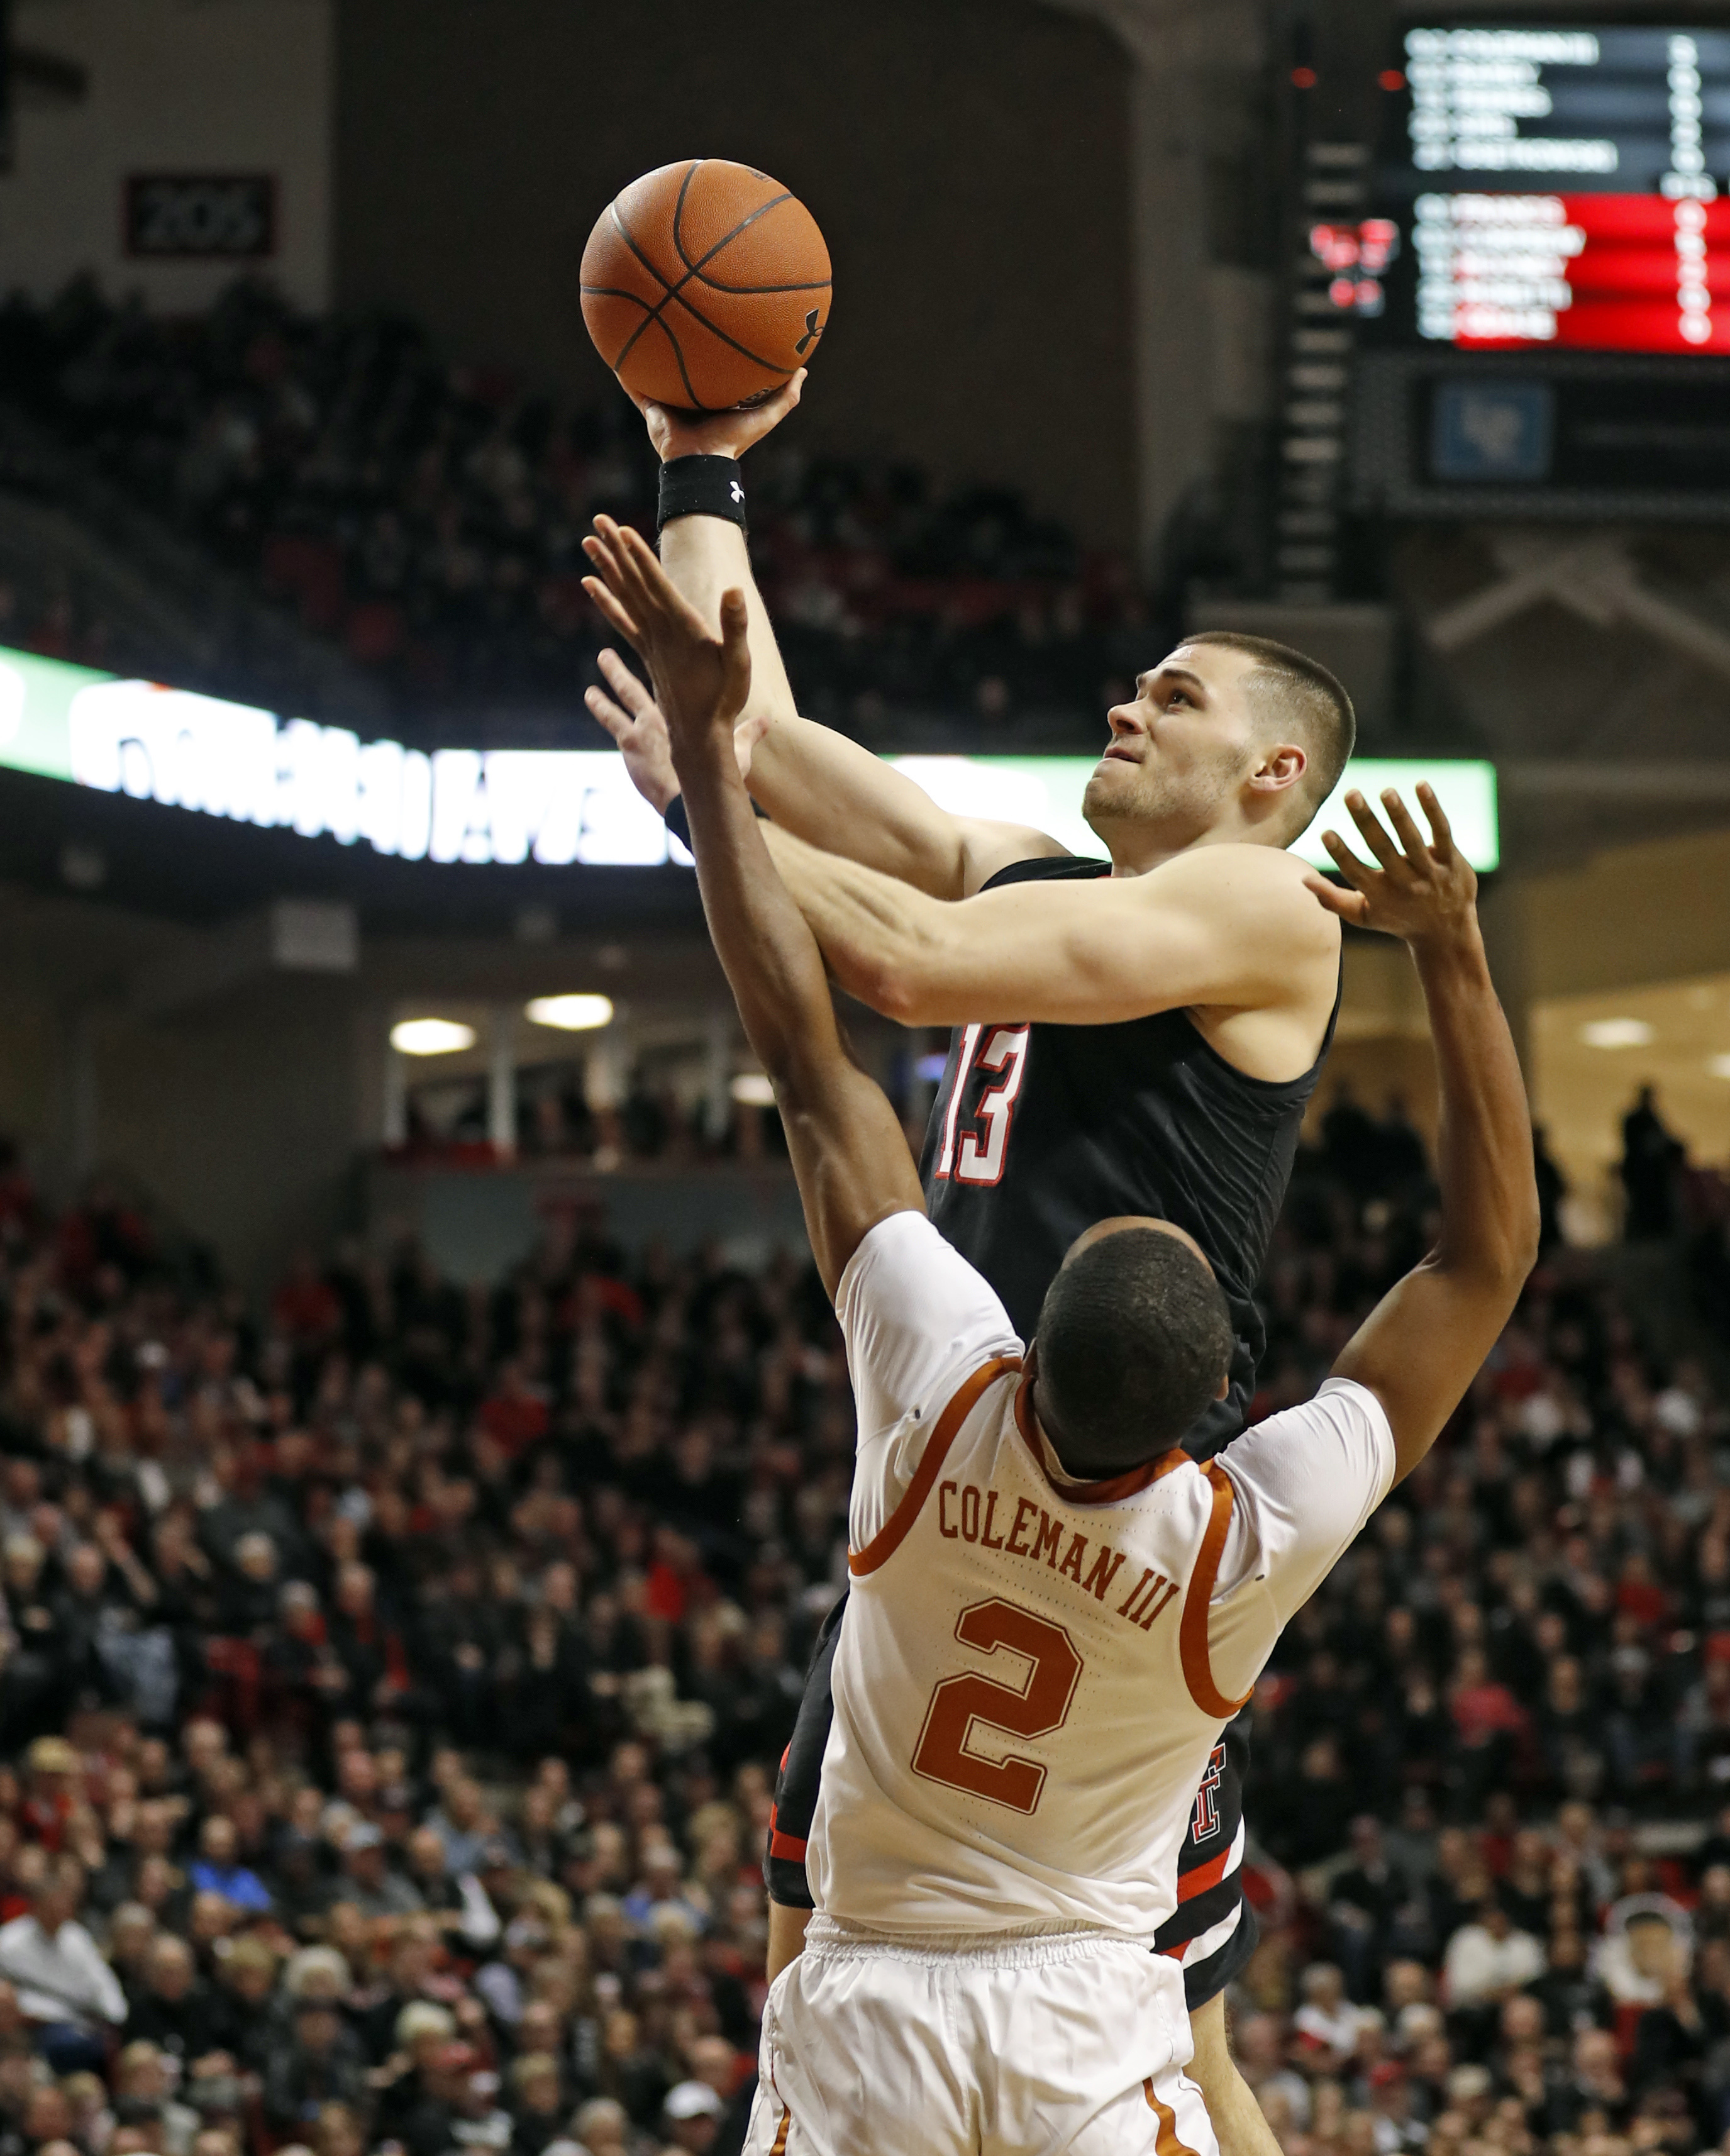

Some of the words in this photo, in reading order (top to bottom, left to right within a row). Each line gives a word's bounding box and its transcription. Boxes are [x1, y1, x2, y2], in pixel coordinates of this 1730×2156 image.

[934, 1022, 1031, 1187] 13
[939, 1480, 1127, 1601] COLEMAN
[1116, 1567, 1181, 1632] III
[911, 1596, 1084, 1816] 2
